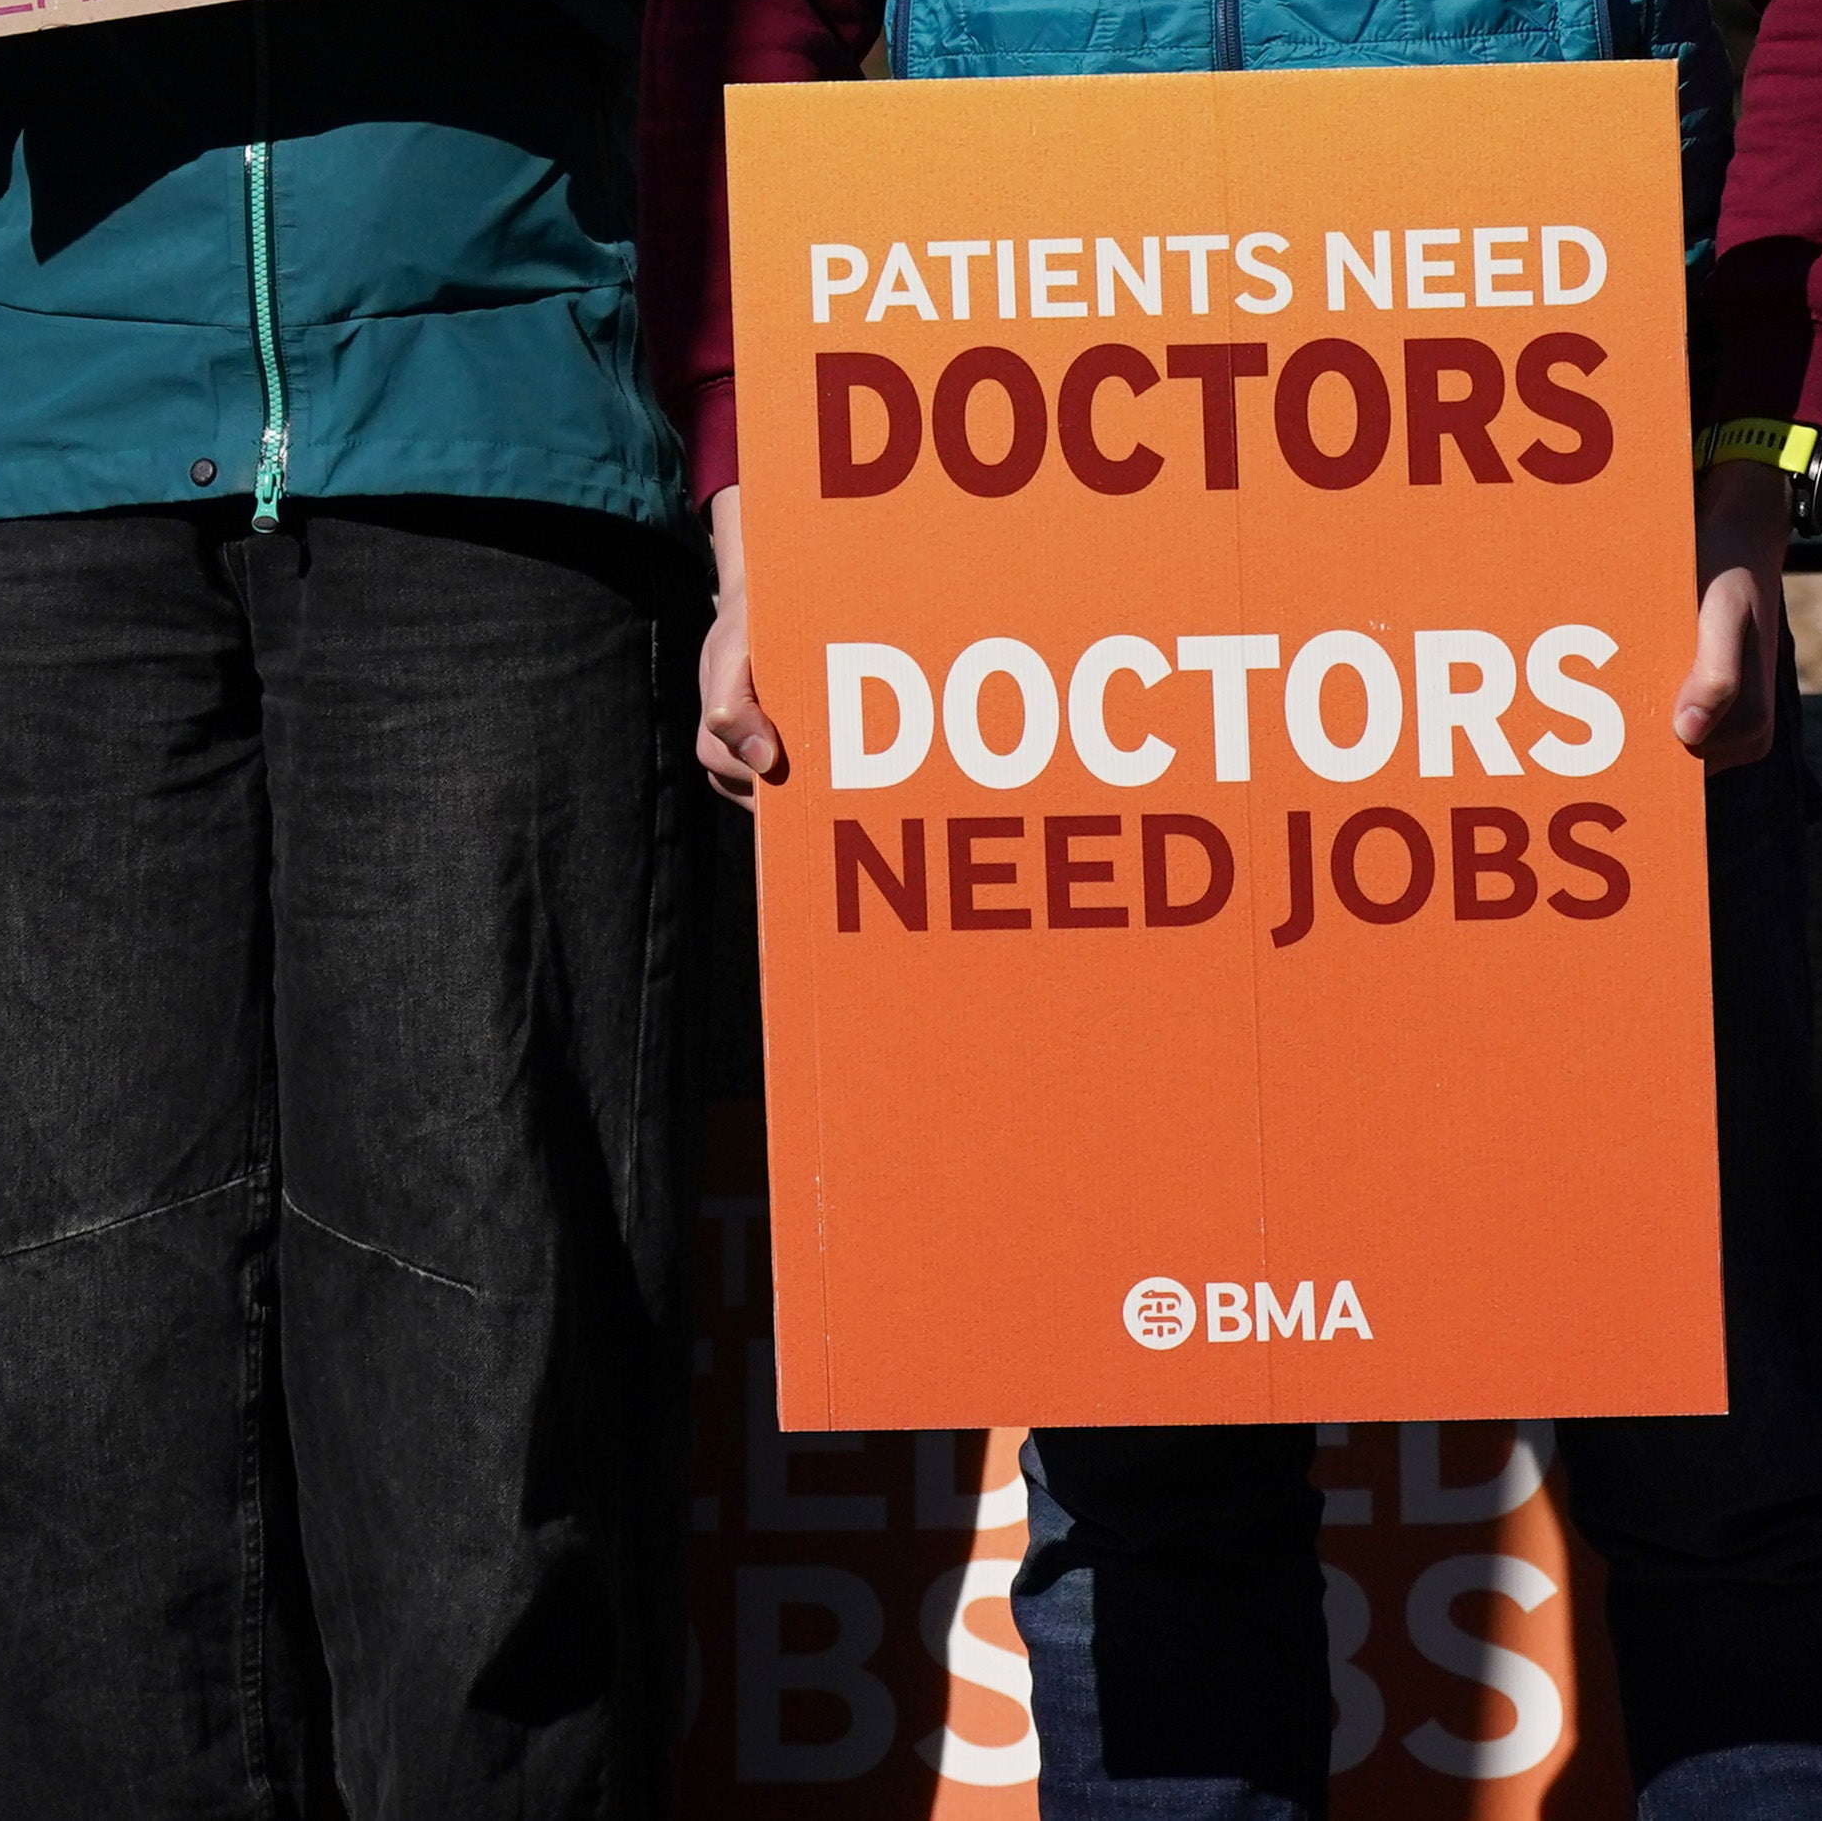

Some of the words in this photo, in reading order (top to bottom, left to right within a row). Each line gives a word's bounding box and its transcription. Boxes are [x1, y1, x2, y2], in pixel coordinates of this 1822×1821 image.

[809, 231, 1294, 324] PATIENTS
[1326, 224, 1608, 311] NEED
[814, 331, 1615, 499] DOCTORS
[825, 624, 1627, 790] DOCTORS
[832, 812, 1236, 934] NEED
[1270, 801, 1633, 949] JOBS
[1205, 1279, 1375, 1344] BMA
